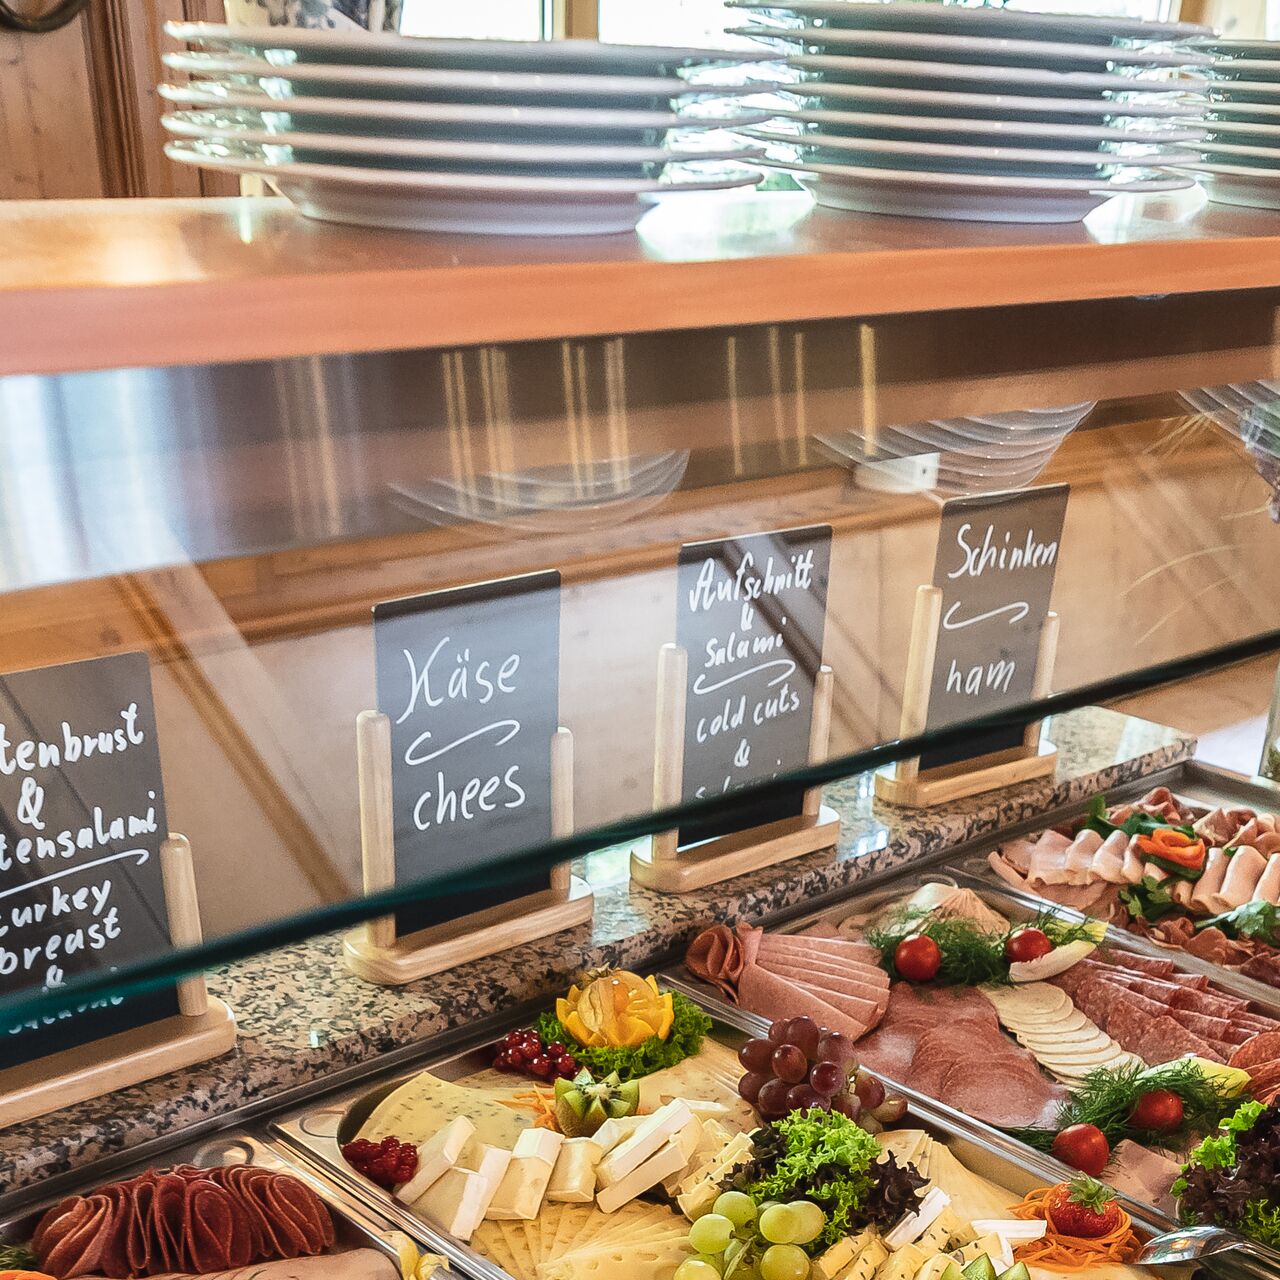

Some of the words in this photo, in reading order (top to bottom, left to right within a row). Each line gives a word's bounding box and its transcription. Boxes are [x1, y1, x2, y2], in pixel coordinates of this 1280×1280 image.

[948, 523, 1057, 578] Schinken
[688, 549, 814, 613] Aufschnitt
[396, 636, 520, 724] Käse
[753, 683, 800, 726] cuts
[945, 659, 1016, 696] ham
[16, 777, 45, 830] &
[413, 765, 526, 831] chees
